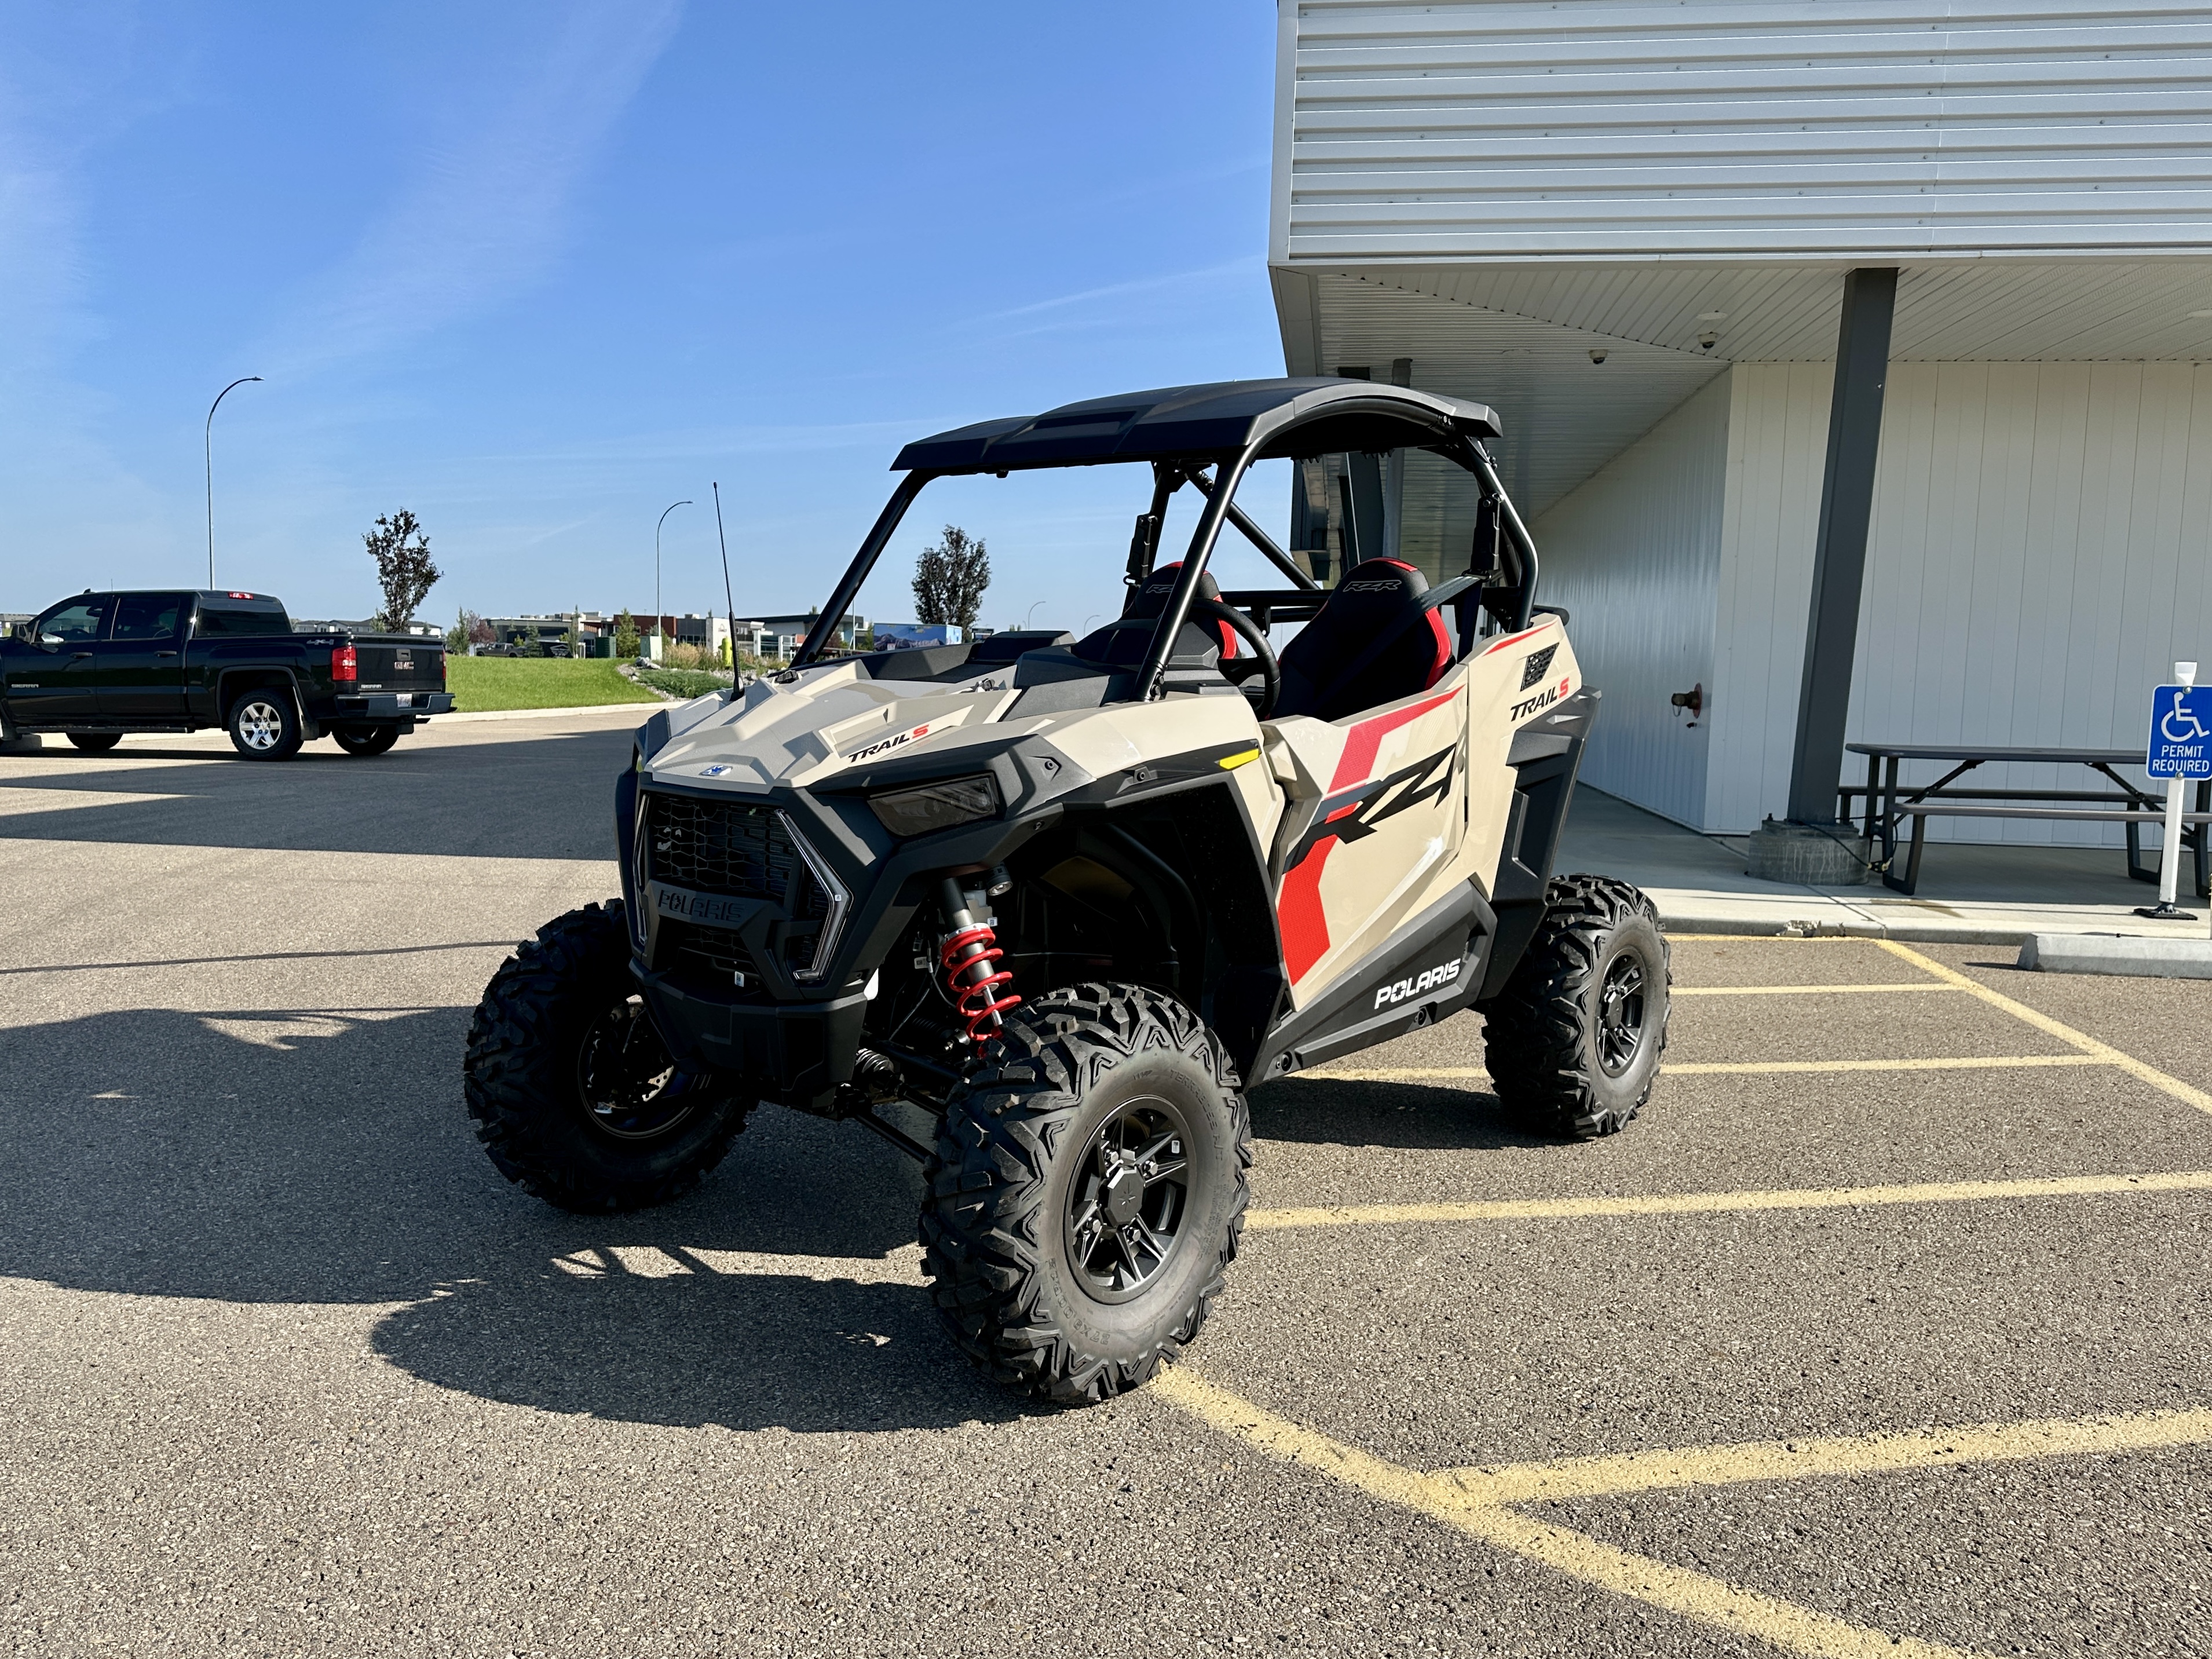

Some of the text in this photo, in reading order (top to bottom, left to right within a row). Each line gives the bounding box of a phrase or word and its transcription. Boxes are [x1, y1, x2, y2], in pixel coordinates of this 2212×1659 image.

[1146, 584, 1175, 594] RZ
[1343, 579, 1402, 592] RZR
[1510, 677, 1570, 722] TRAIL S
[848, 724, 930, 763] TRAIL S
[2161, 745, 2204, 758] PERMIT
[2152, 759, 2210, 772] REQUIRED
[658, 889, 745, 922] POLARIS
[1374, 958, 1461, 1010] POLARIS
